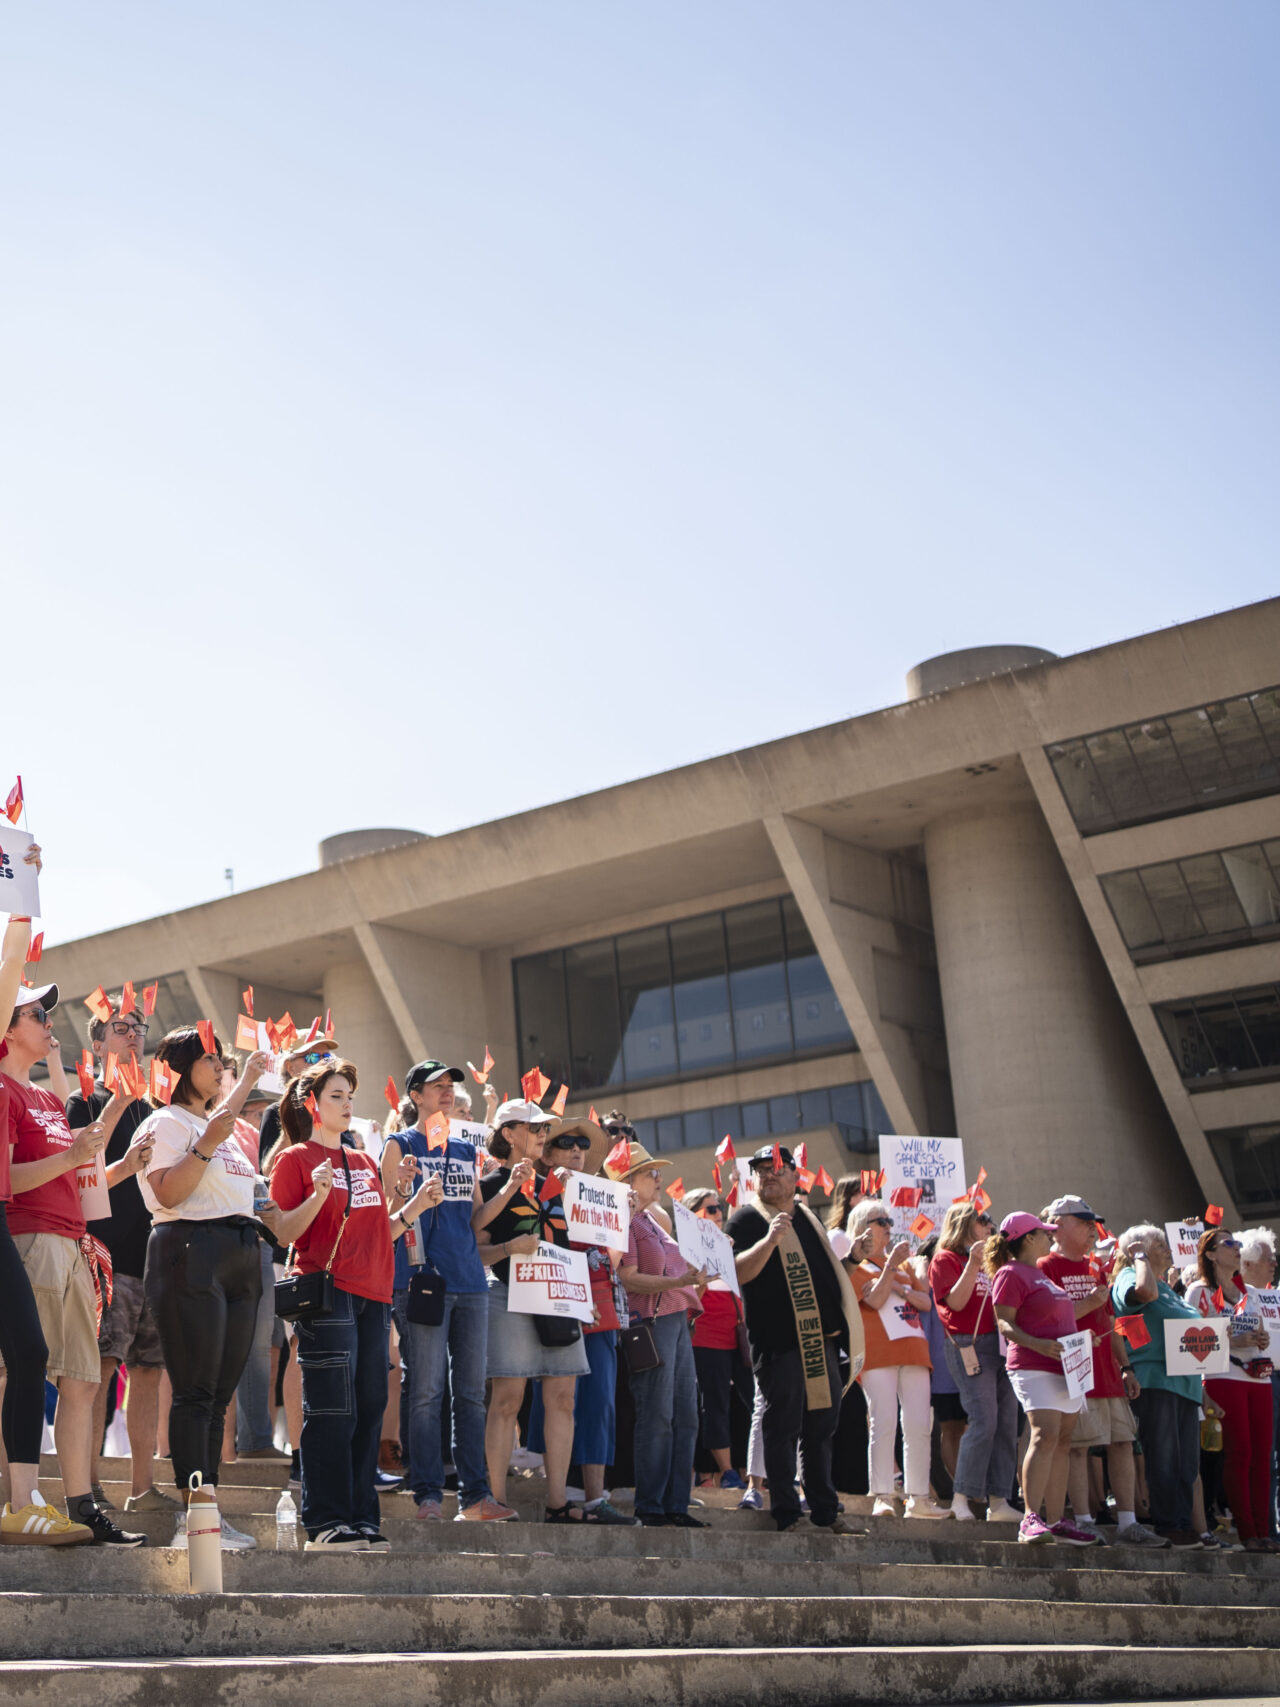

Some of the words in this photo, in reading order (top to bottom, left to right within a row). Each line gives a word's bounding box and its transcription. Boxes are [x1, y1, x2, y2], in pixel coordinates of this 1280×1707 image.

[900, 1138, 923, 1152] WILL
[927, 1139, 941, 1152] MY
[903, 1165, 915, 1177] BE
[920, 1161, 956, 1179] NEXT?
[448, 1174, 473, 1185] OUR
[579, 1181, 605, 1206] Protect
[606, 1193, 618, 1209] us.
[571, 1203, 589, 1224] Not
[591, 1206, 602, 1228] the
[603, 1210, 623, 1233] NRA.
[786, 1251, 800, 1264] DO
[1061, 1275, 1086, 1284] MOMS
[786, 1263, 817, 1312] JUSTICE
[798, 1316, 820, 1332] LOVE
[1229, 1315, 1259, 1326] EMAND
[1180, 1336, 1197, 1344] GUN
[1199, 1335, 1219, 1343] LAWS
[1179, 1344, 1199, 1353] SAVE
[1200, 1343, 1221, 1352] LIVES
[800, 1332, 825, 1379] MERCY
